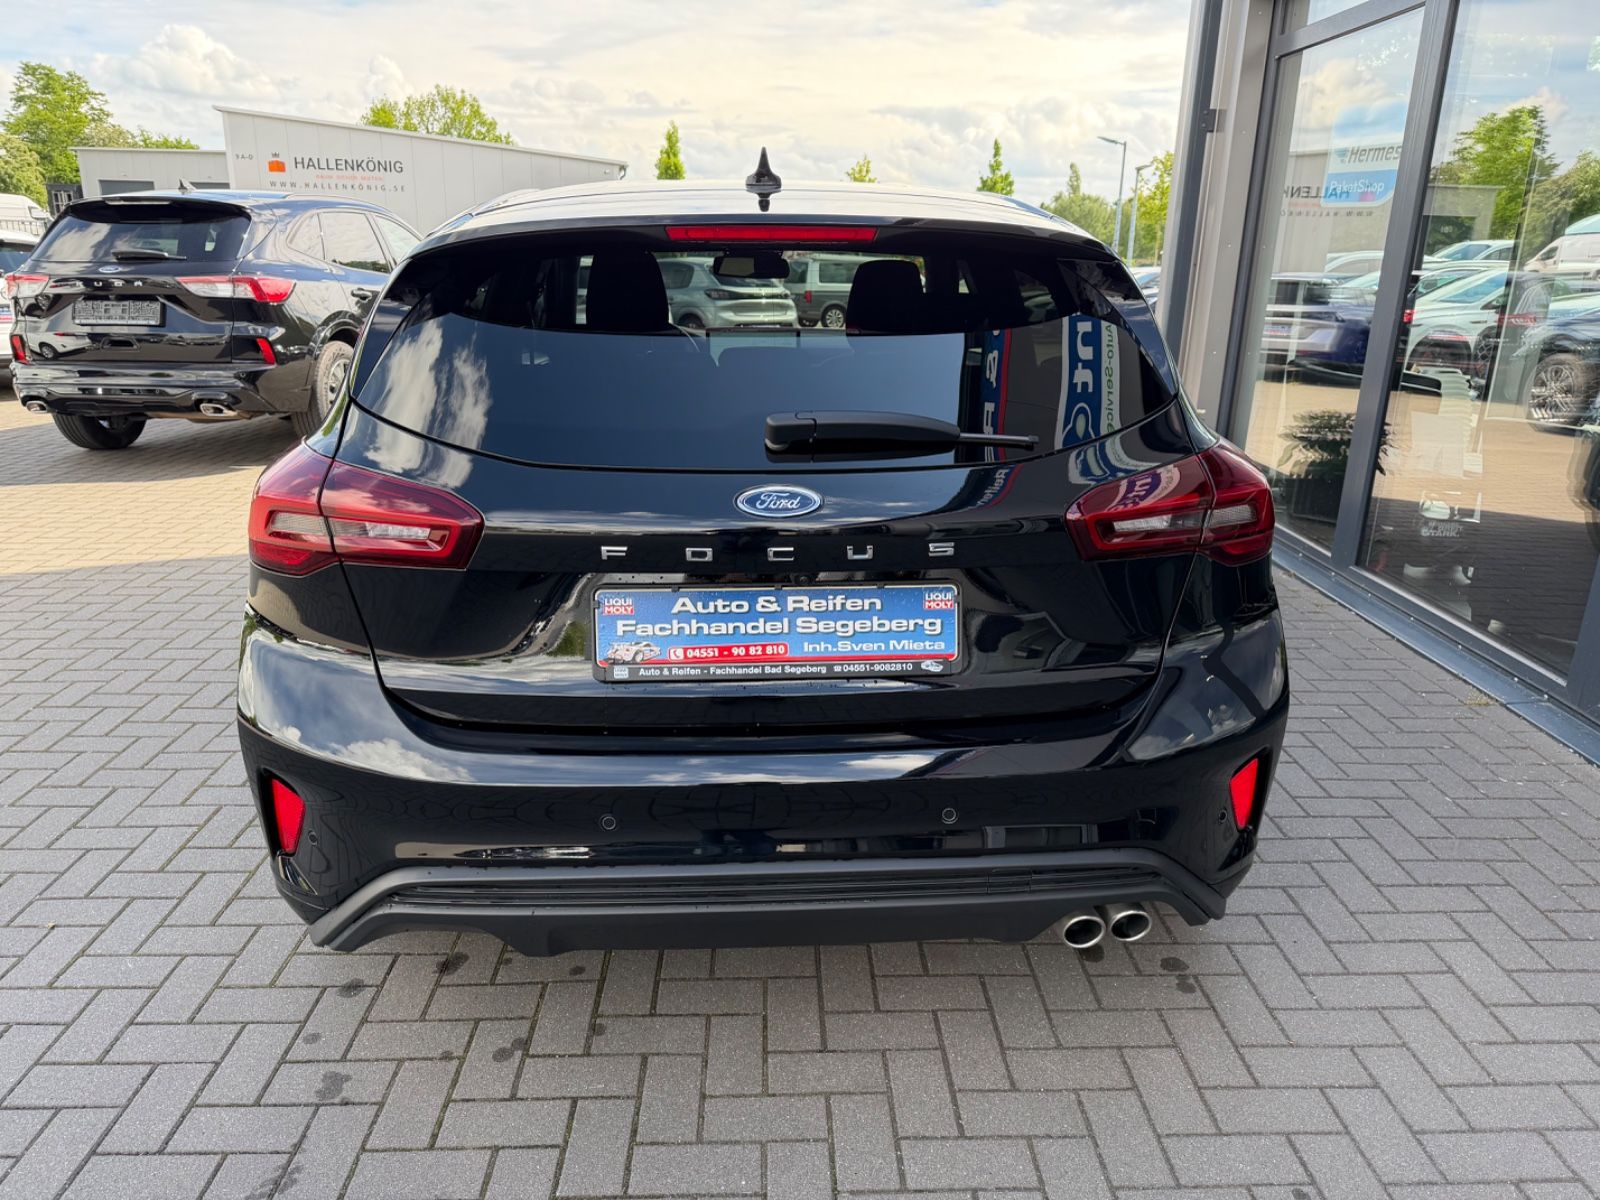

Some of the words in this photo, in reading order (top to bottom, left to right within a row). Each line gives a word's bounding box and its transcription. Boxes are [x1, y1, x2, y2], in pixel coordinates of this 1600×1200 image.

[1348, 145, 1402, 163] Hermes
[294, 156, 404, 173] HALLENKÖNIG
[1329, 179, 1385, 195] PaketShop
[756, 492, 801, 510] Ford
[601, 543, 955, 562] FOCUS
[604, 598, 633, 606] LIQUI
[925, 592, 952, 600] LIQUI
[604, 606, 634, 614] MOLY
[671, 597, 750, 614] Auto
[756, 595, 781, 612] &
[787, 595, 882, 612] Reifen
[924, 600, 954, 609] MOLY
[616, 618, 789, 636] Fachhandel
[796, 616, 942, 637] Segeberg
[686, 648, 719, 658] 04551
[731, 647, 746, 656] 90
[748, 646, 763, 655] 82
[765, 645, 785, 655] 810
[639, 667, 661, 676] Auto
[672, 667, 701, 676] Reifen
[710, 666, 762, 675] Fachhandel
[764, 665, 782, 674] Bad
[784, 665, 827, 675] Segeberg
